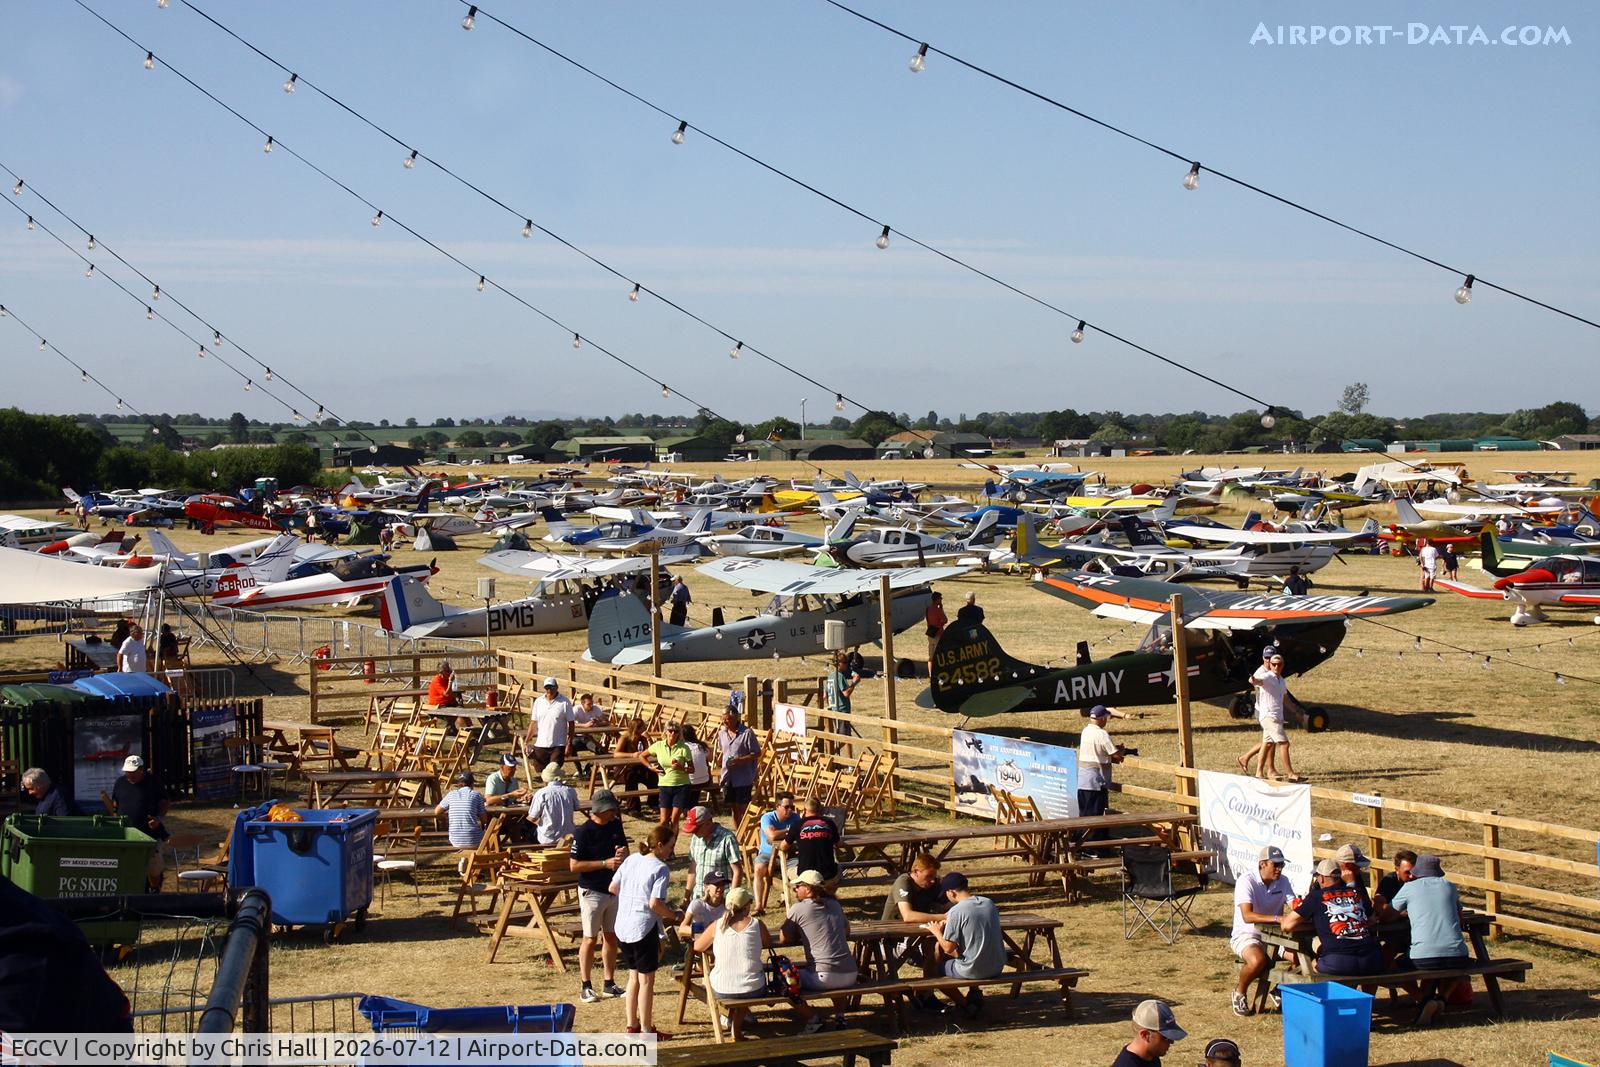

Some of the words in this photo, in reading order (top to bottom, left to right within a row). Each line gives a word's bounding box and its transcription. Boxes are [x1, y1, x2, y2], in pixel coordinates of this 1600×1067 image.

[489, 605, 535, 632] BMG
[1053, 669, 1126, 705] ARMY
[1228, 796, 1278, 821] Cambrai
[59, 877, 77, 891] PG
[80, 877, 118, 892] SKIPS
